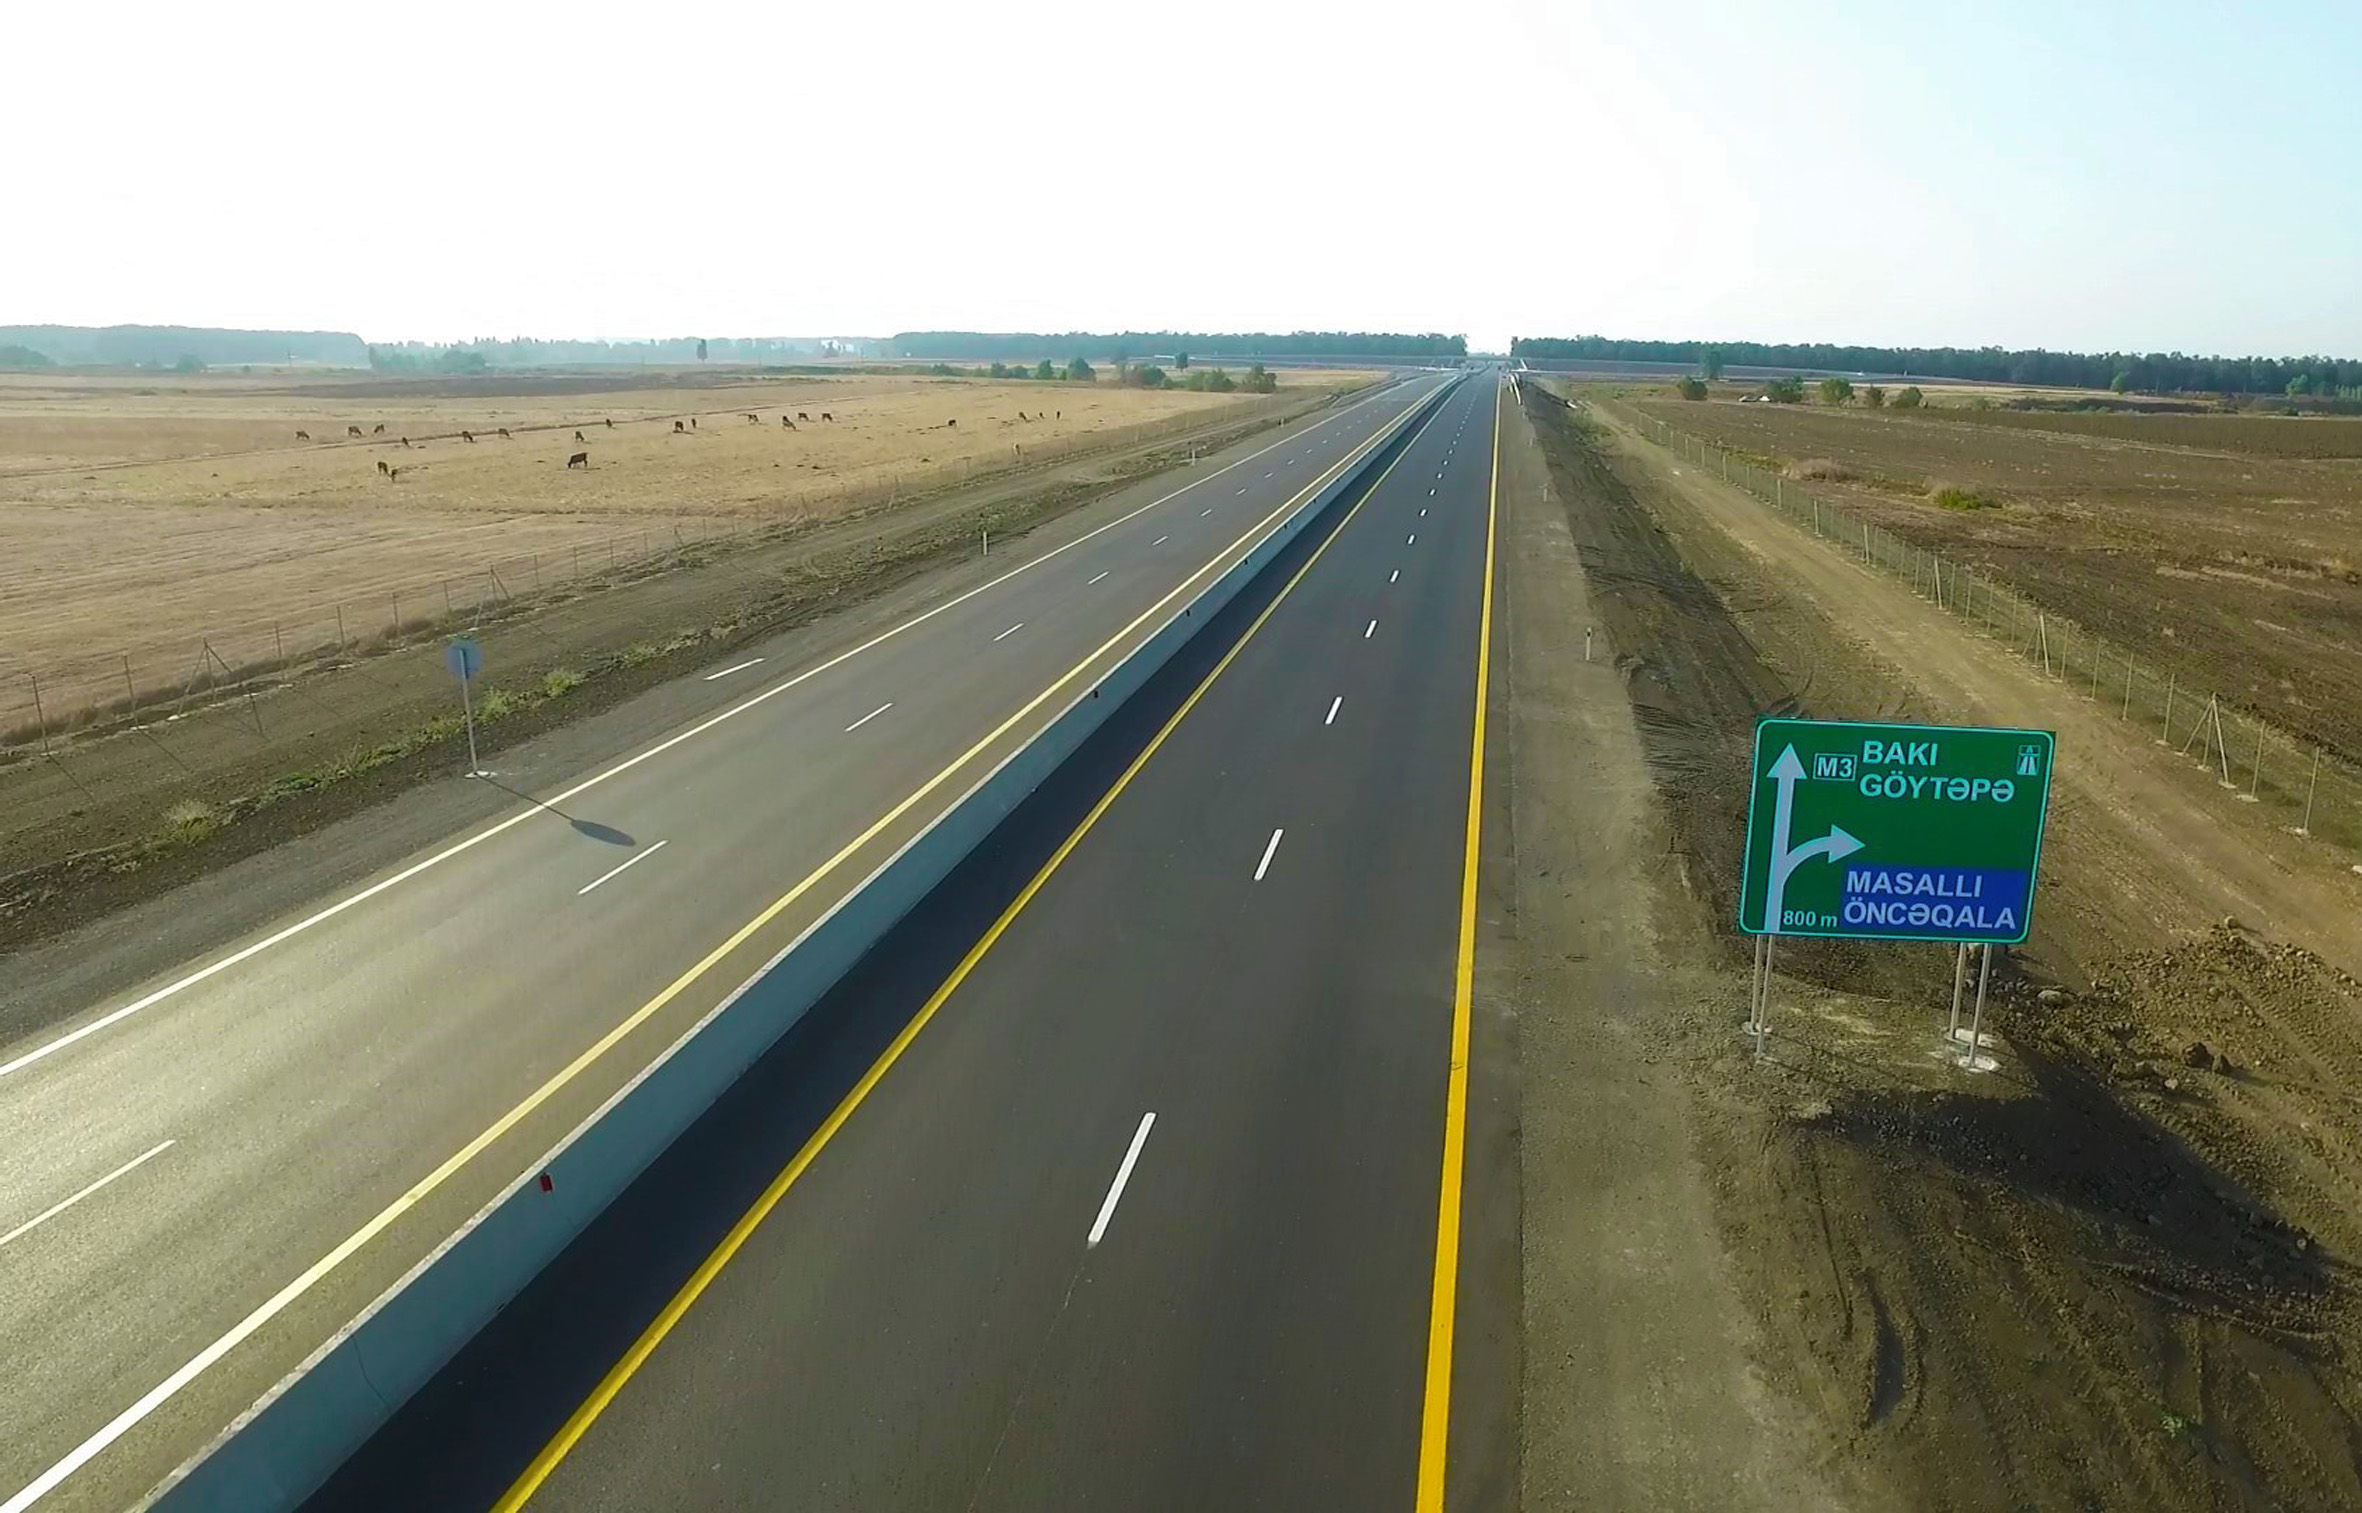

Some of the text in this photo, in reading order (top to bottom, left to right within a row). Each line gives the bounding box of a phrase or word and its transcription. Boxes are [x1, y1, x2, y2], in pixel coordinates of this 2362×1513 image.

[1862, 740, 1939, 766] BAKI
[1816, 756, 1854, 778] M3
[1859, 770, 2015, 802] GÖYTƏPƏ
[1846, 870, 1983, 898] MASALLI
[1783, 910, 1838, 928] 800 m
[1843, 896, 2016, 929] ÖNCƏQALA
